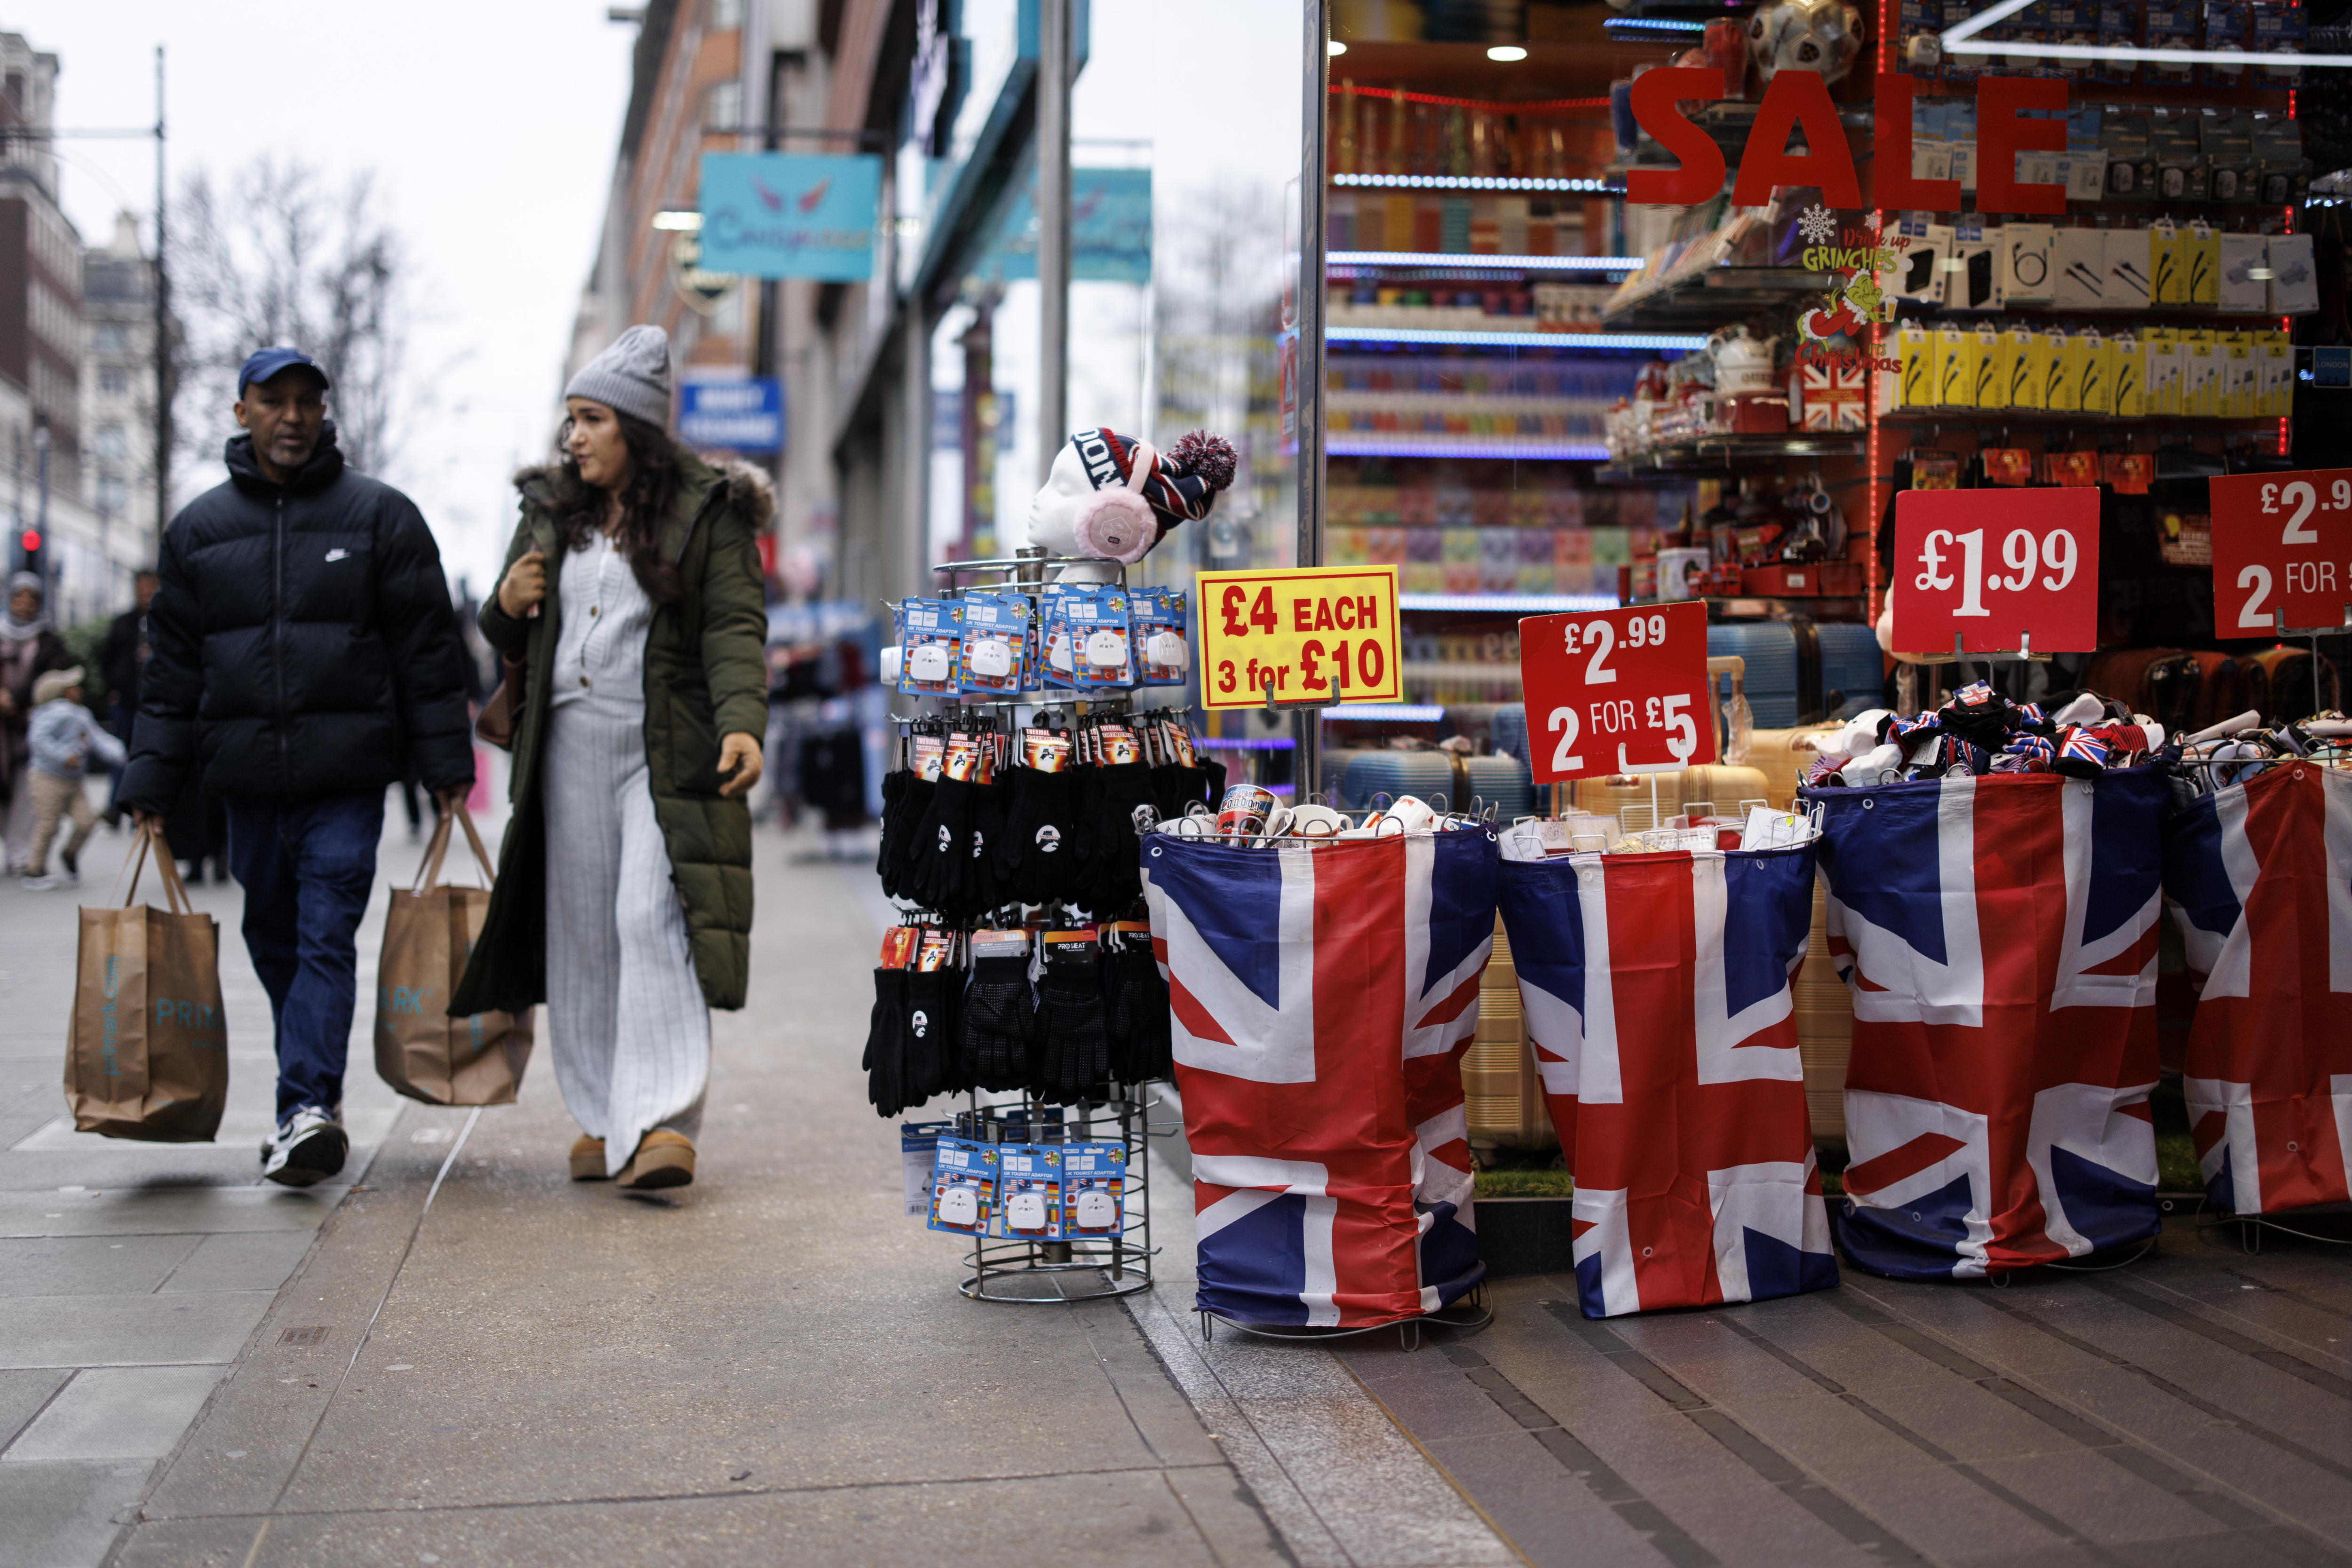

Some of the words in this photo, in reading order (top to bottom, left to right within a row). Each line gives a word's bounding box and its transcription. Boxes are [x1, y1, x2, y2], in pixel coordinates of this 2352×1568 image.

[1626, 67, 2068, 216] SALE
[1802, 246, 1897, 274] GRINCHES
[1844, 229, 1888, 247] Drink
[1891, 236, 1911, 253] up
[1794, 341, 1903, 373] Christmas
[2261, 479, 2352, 545] £2.9
[1915, 528, 2077, 617] £1.99
[2237, 564, 2273, 628] 2
[2286, 562, 2336, 594] FOR
[1028, 608, 1036, 617] K
[1221, 585, 1278, 637] £4
[1293, 595, 1377, 632] EACH
[1218, 660, 1236, 693] 3
[1246, 658, 1290, 692] for
[1300, 639, 1384, 691] £10
[1565, 615, 1666, 685] £2.99
[917, 737, 940, 746] THERMAL
[1548, 706, 1583, 772] 2
[1590, 700, 1637, 734] FOR
[1646, 694, 1697, 759] £5
[1220, 795, 1261, 812] London
[1228, 789, 1256, 798] England
[99, 956, 120, 1076] primark.com
[156, 998, 227, 1030] PRIM
